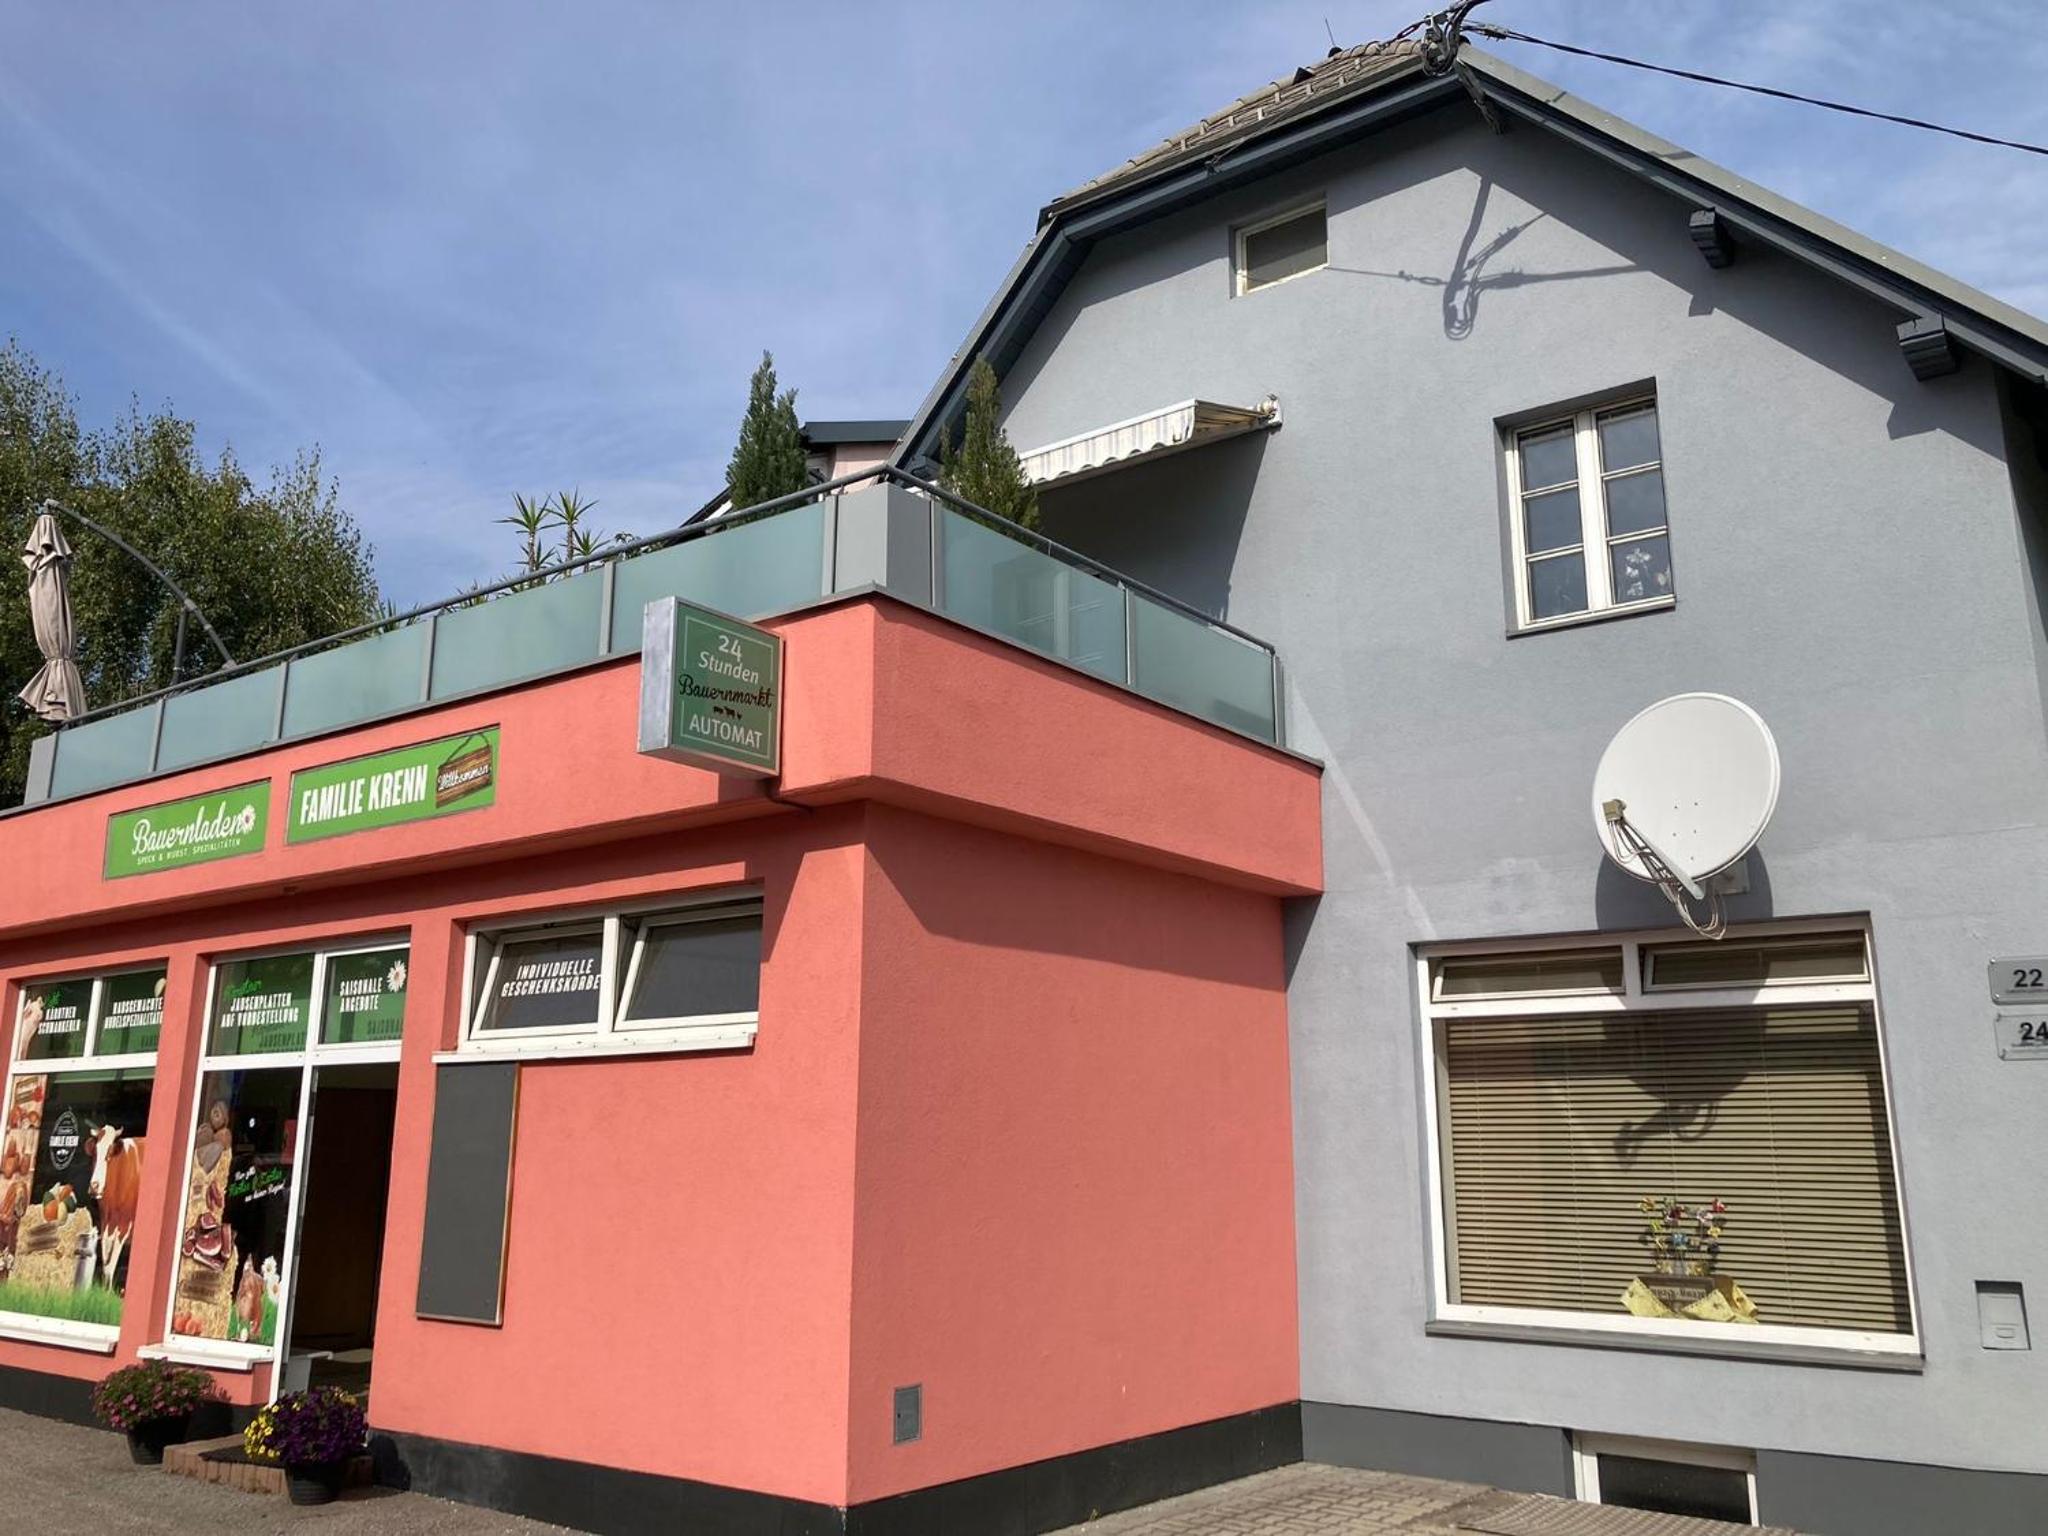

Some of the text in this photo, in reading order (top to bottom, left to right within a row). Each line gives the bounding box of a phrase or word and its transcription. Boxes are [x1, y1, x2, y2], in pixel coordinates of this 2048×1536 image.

[718, 635, 742, 662] 24
[698, 651, 760, 684] Stunden
[678, 673, 775, 708] Bauernmarkt
[689, 714, 763, 749] AUTOMAT
[300, 764, 429, 825] FAMILIE KRENN
[131, 800, 244, 855] Bauernladen
[516, 958, 595, 981] INDIVIDUELLE
[2013, 968, 2045, 988] 22
[339, 977, 384, 997] SAISONALE
[230, 992, 293, 1013] JAUSENPLATTEN
[339, 994, 380, 1013] ANGEBOTE
[220, 1007, 300, 1029] AUF VORBESTELLUNG
[2020, 1021, 2048, 1041] 24
